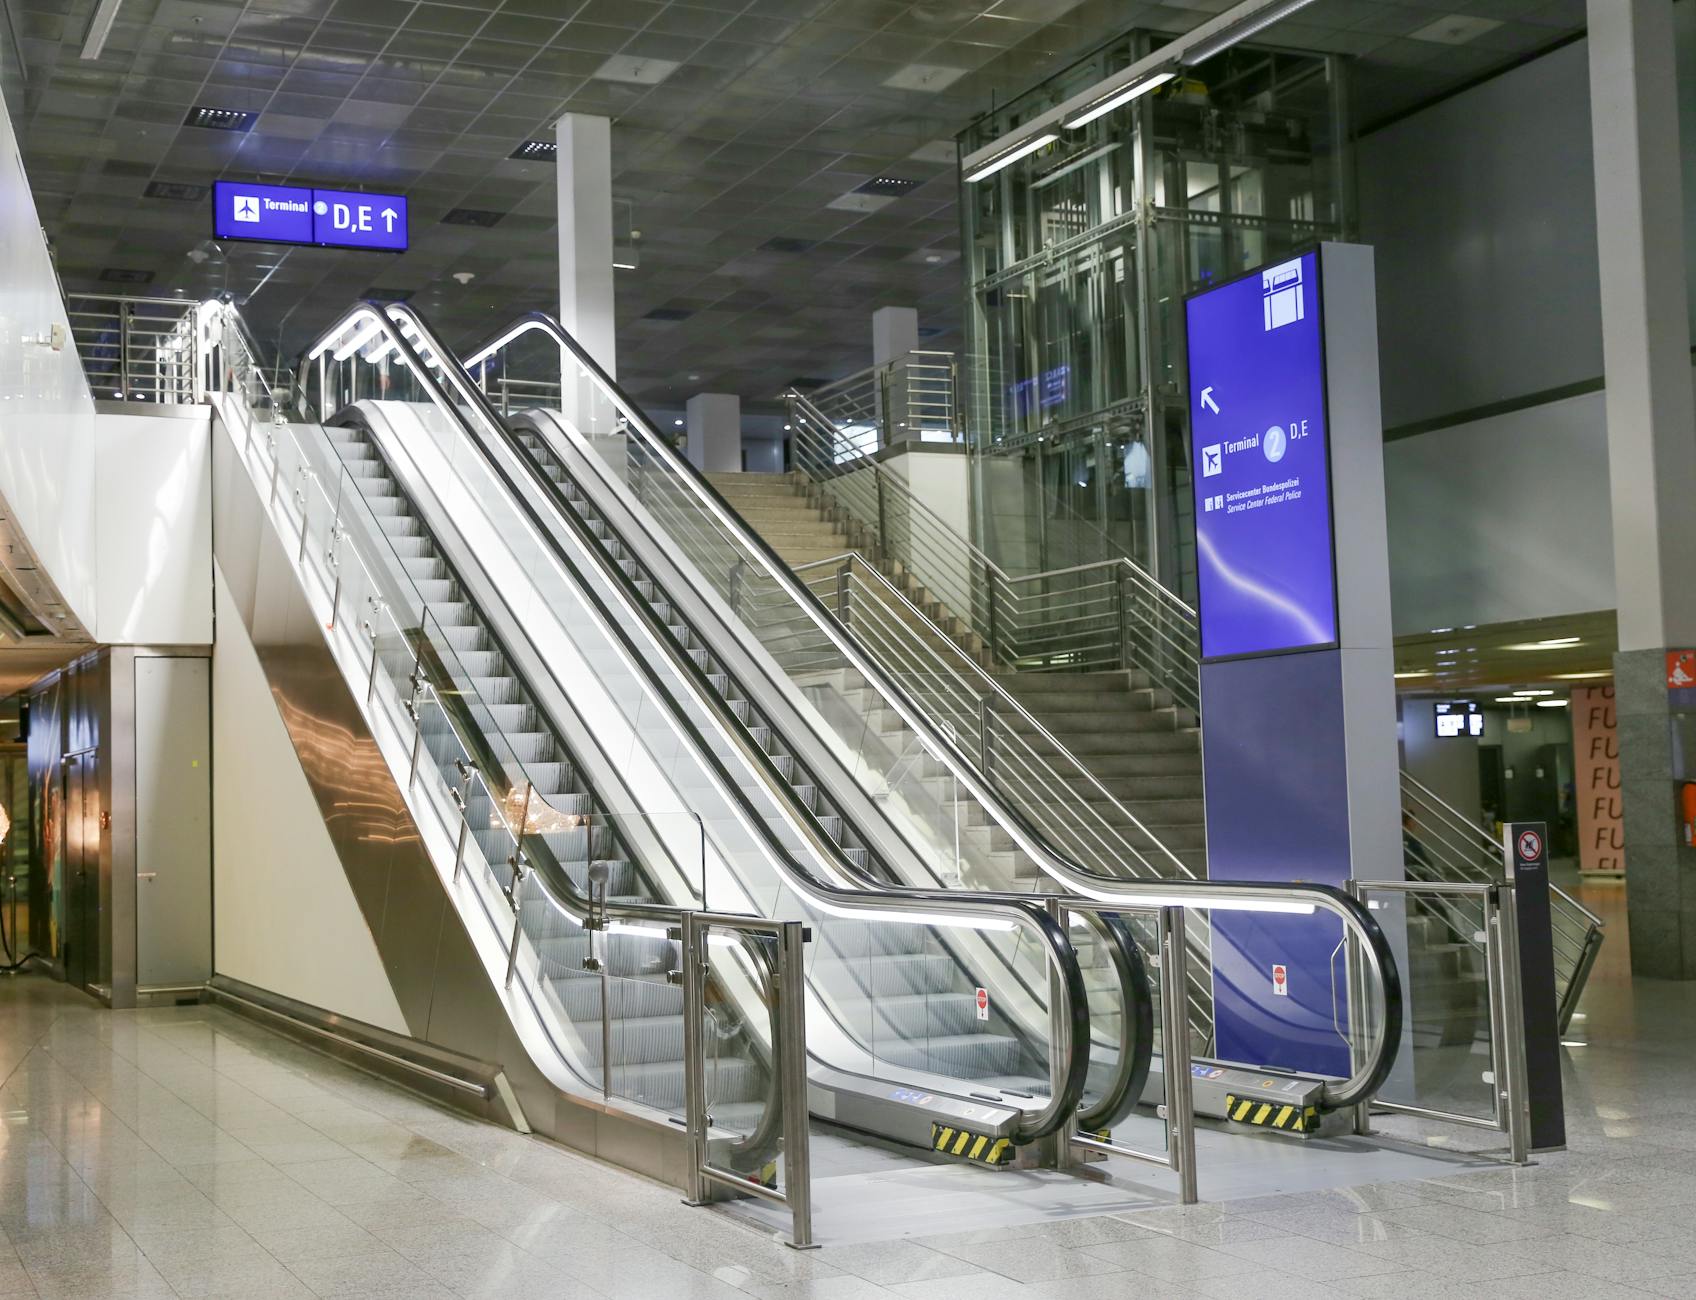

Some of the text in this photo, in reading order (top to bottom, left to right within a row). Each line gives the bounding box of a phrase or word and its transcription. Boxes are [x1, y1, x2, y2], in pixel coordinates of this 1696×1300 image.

[263, 198, 309, 213] Terminal
[333, 203, 373, 233] D,E
[1223, 433, 1259, 455] Terminal
[1290, 419, 1308, 440] D,E
[1227, 502, 1246, 514] Service
